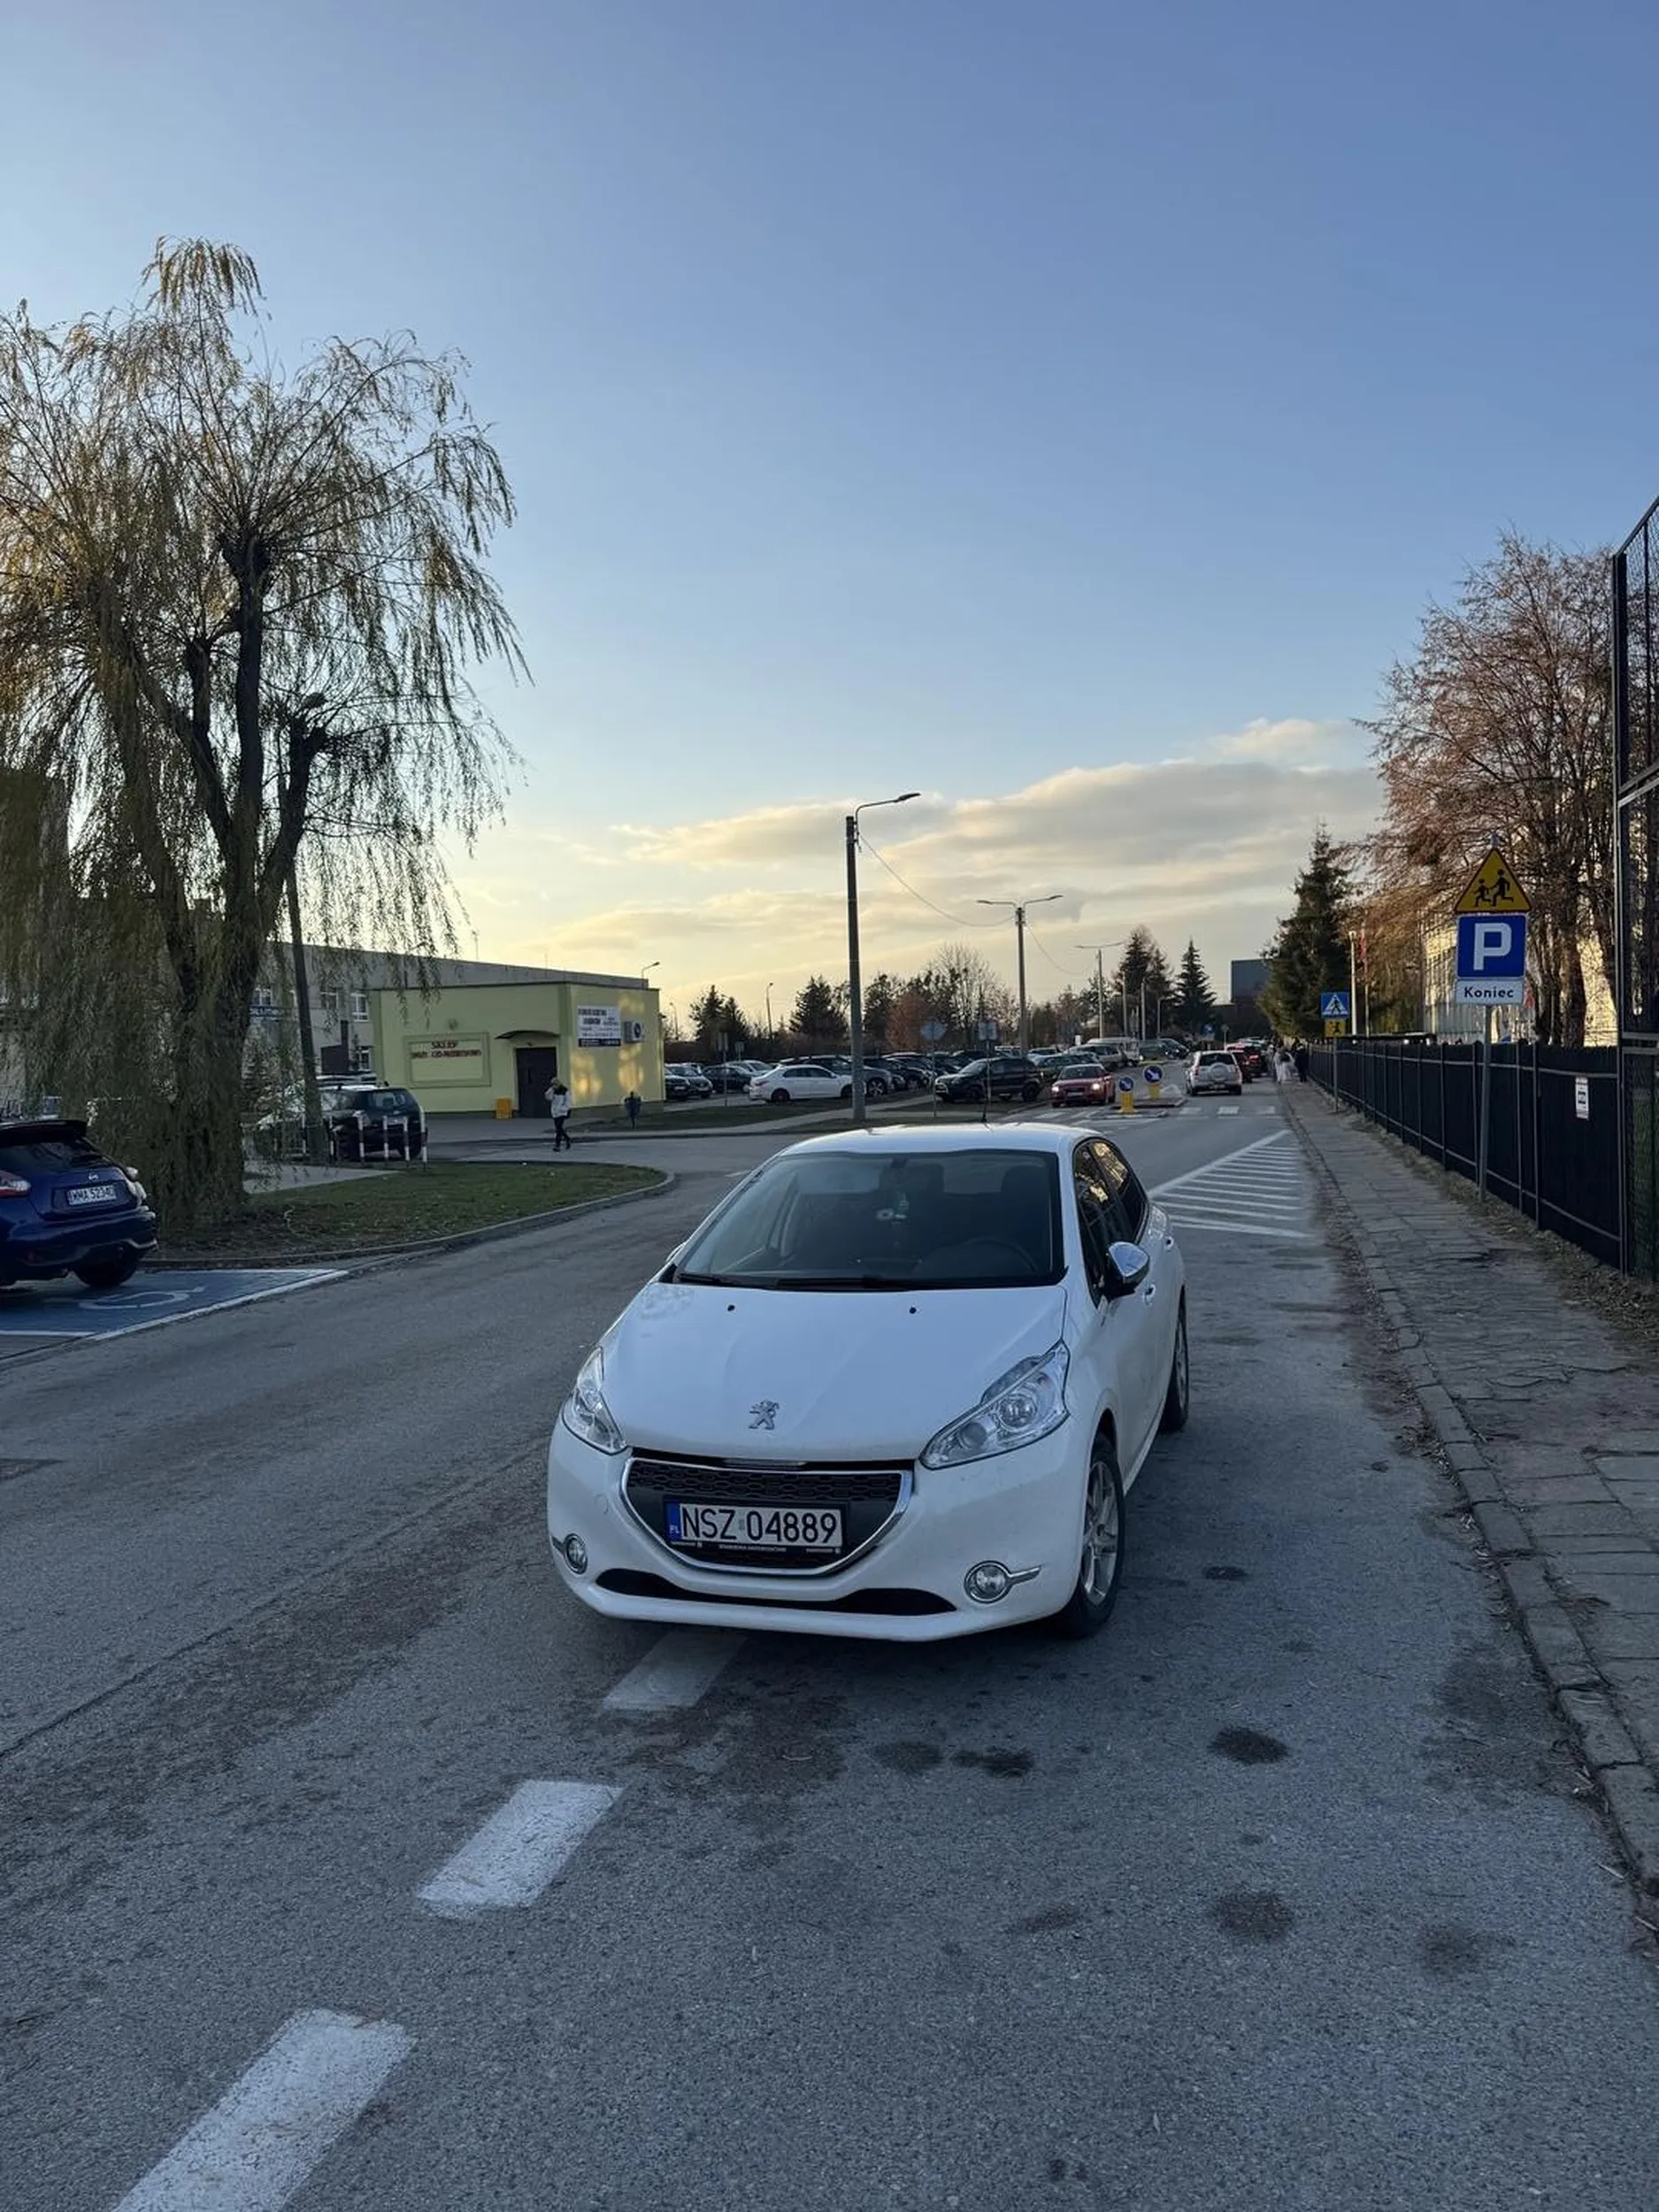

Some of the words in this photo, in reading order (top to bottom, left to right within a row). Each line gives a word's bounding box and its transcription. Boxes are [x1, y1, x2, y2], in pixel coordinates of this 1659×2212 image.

[1473, 923, 1512, 971] P
[1464, 987, 1514, 998] Koniec
[670, 1525, 681, 1535] PL
[682, 1507, 737, 1540] NSZ
[747, 1510, 837, 1543] 04889
